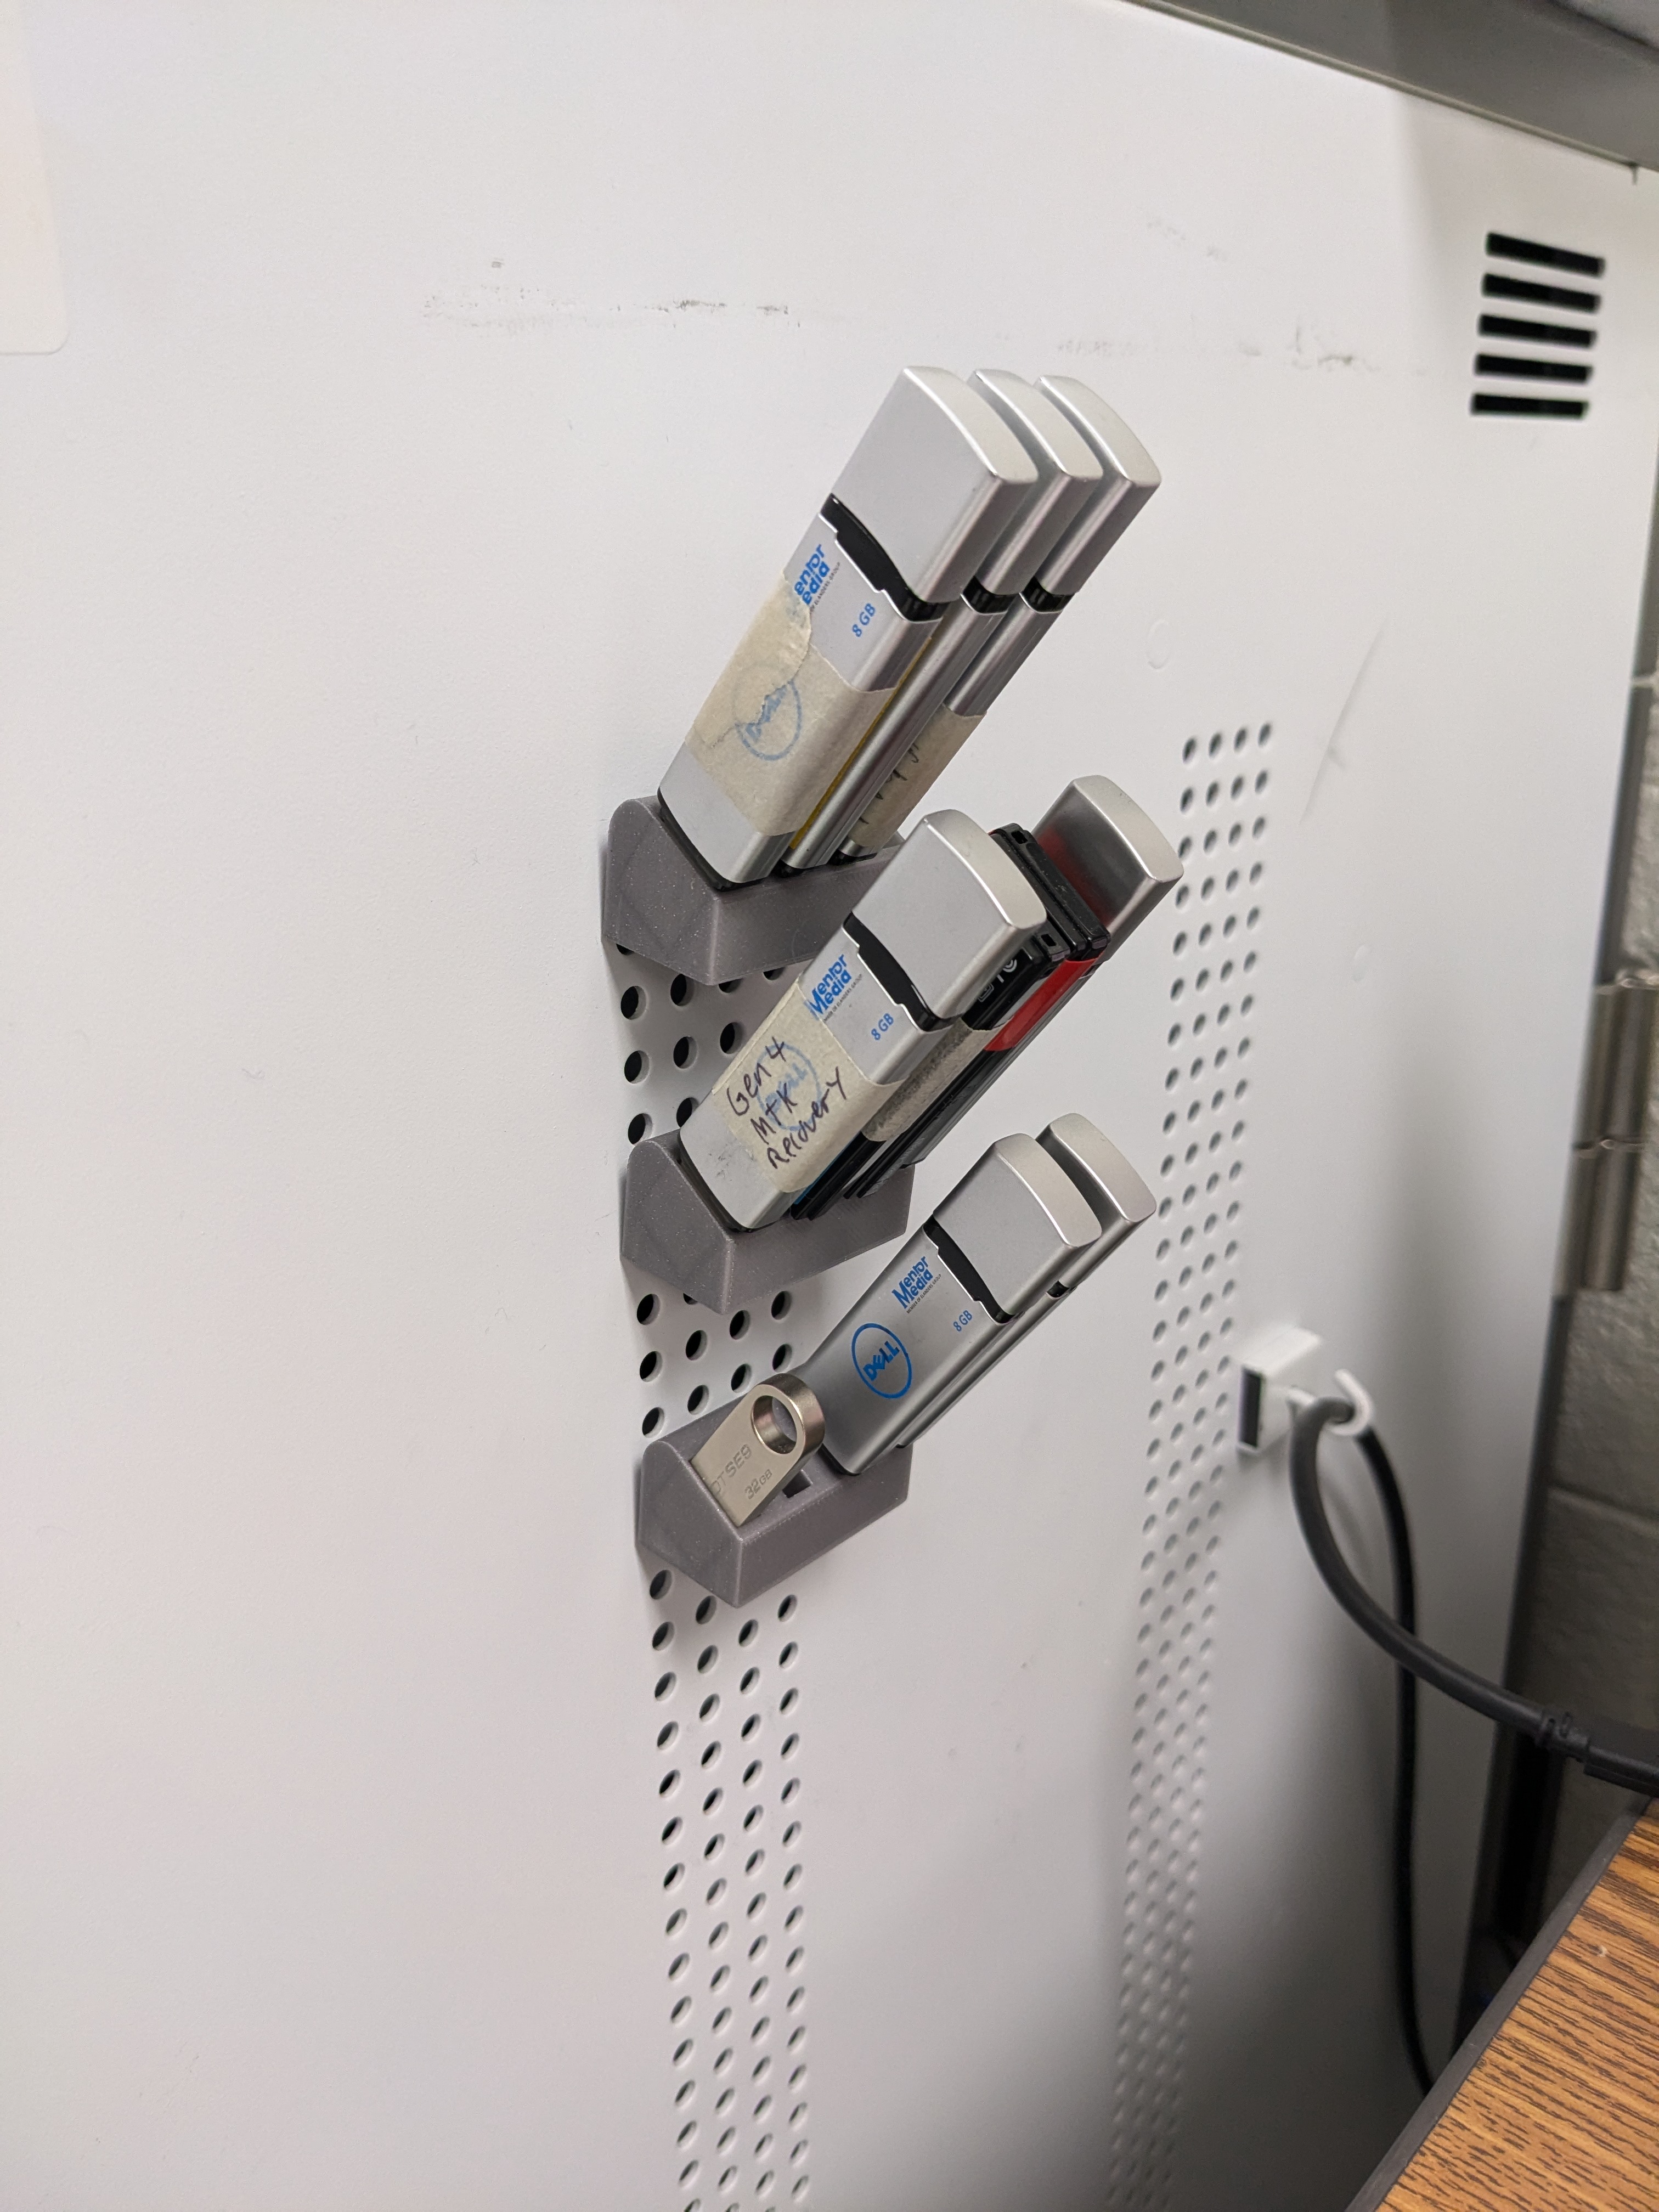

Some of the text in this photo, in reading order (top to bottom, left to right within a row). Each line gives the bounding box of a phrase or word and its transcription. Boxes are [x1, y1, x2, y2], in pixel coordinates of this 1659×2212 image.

[794, 544, 825, 596] entor
[802, 561, 830, 605] edia
[852, 603, 876, 637] 8 GB
[804, 954, 847, 1020] Mentor
[805, 969, 852, 1020] Media
[871, 1013, 894, 1041] 8 GB
[726, 1036, 787, 1116] Gen 4
[891, 1256, 929, 1310] Mentor
[893, 1269, 933, 1310] Media
[906, 1301, 918, 1314] MEMBER
[920, 1284, 933, 1299] ELANDERS
[932, 1273, 941, 1285] GROUP
[953, 1310, 972, 1331] 8 GB
[863, 1340, 900, 1381] DELL
